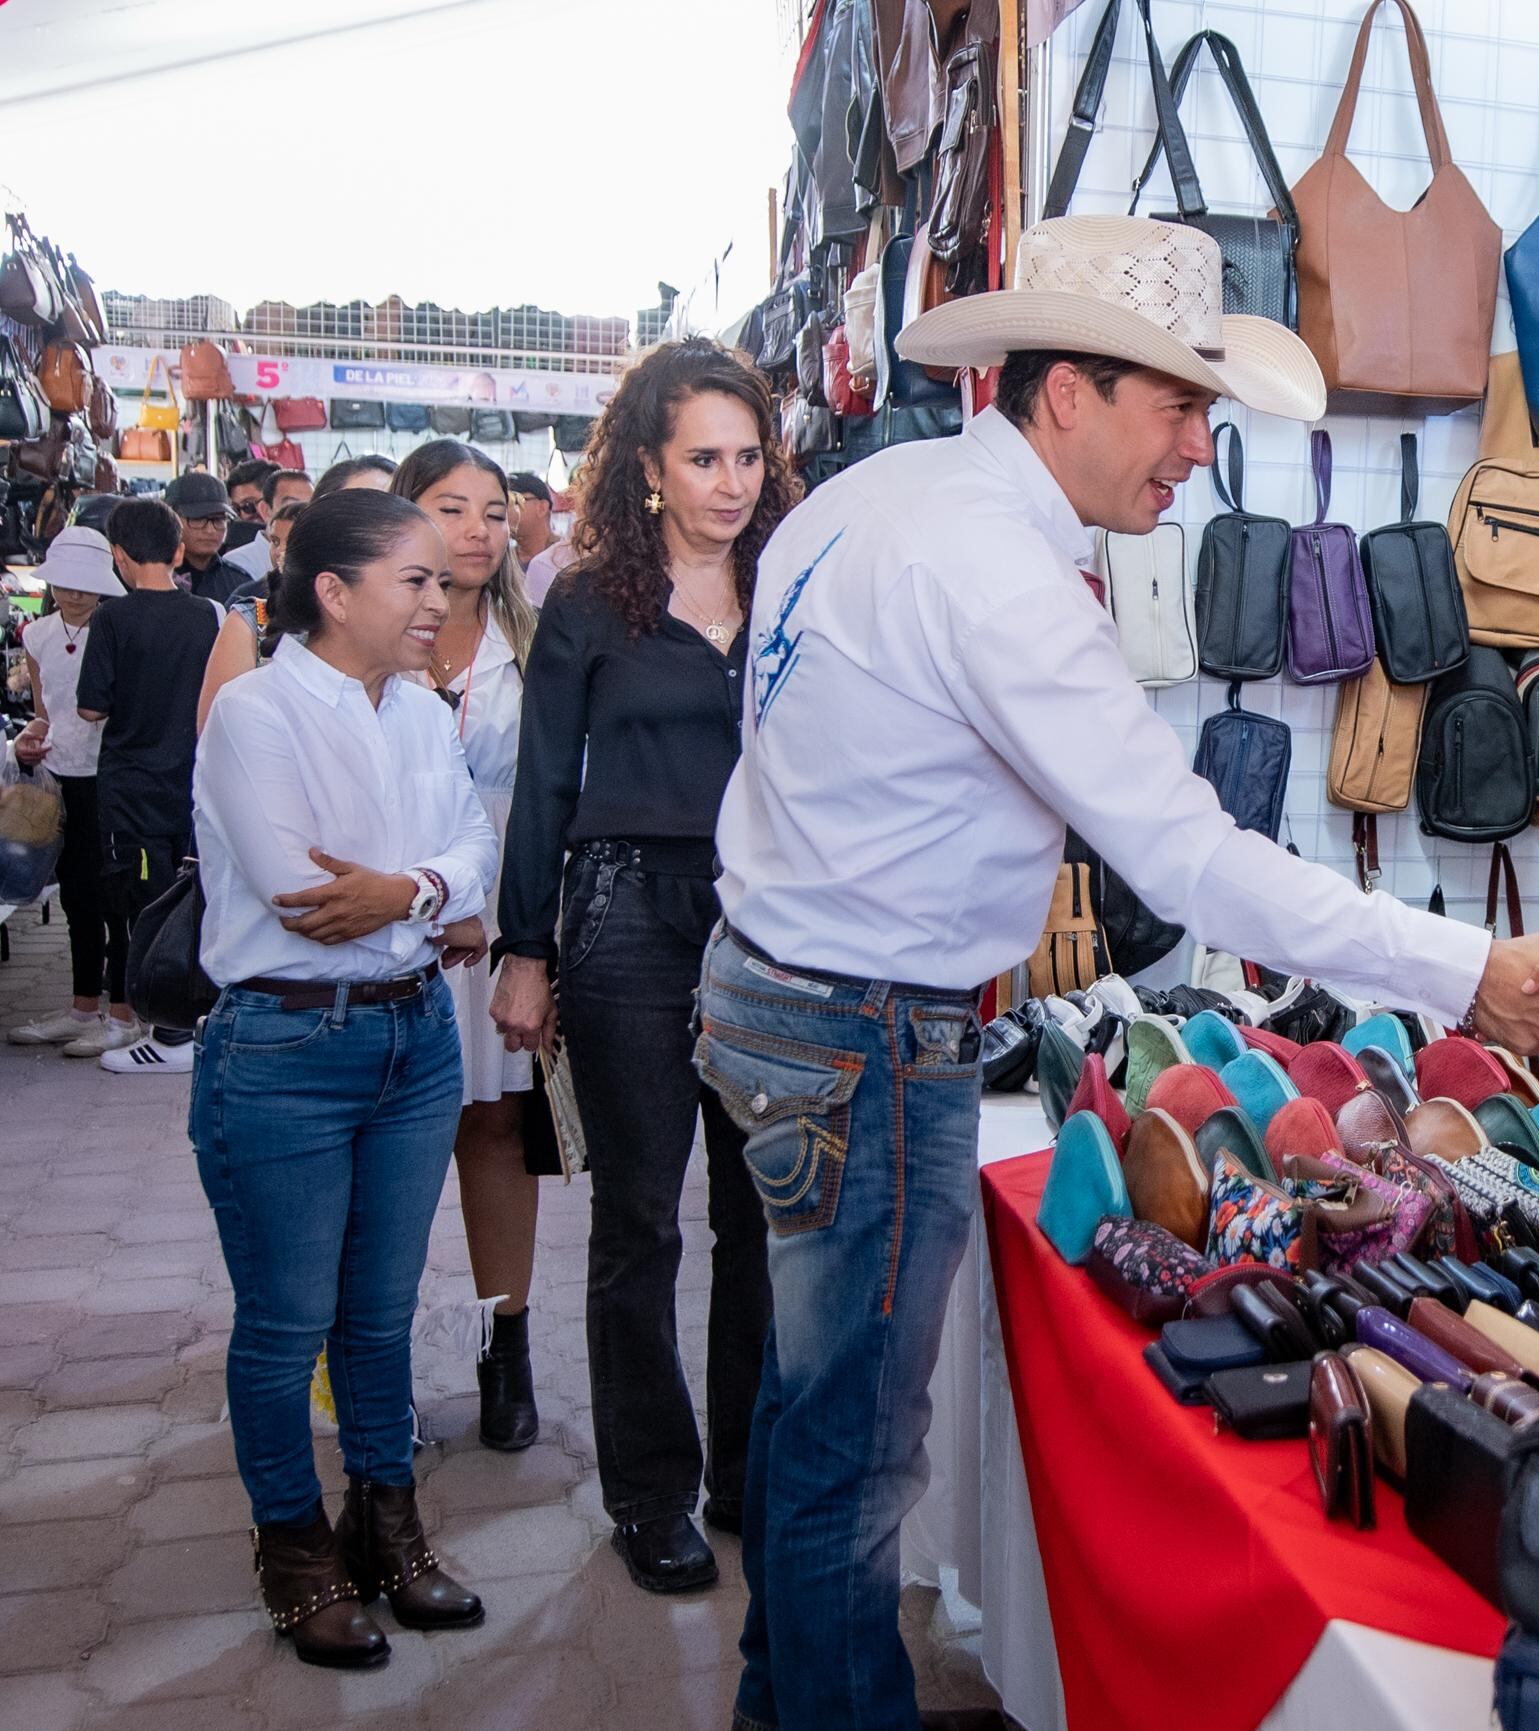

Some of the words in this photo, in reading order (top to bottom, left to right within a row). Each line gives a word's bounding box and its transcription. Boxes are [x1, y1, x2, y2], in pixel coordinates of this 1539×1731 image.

[346, 369, 363, 383] DE
[366, 370, 384, 384] LA
[387, 371, 415, 386] PIEL
